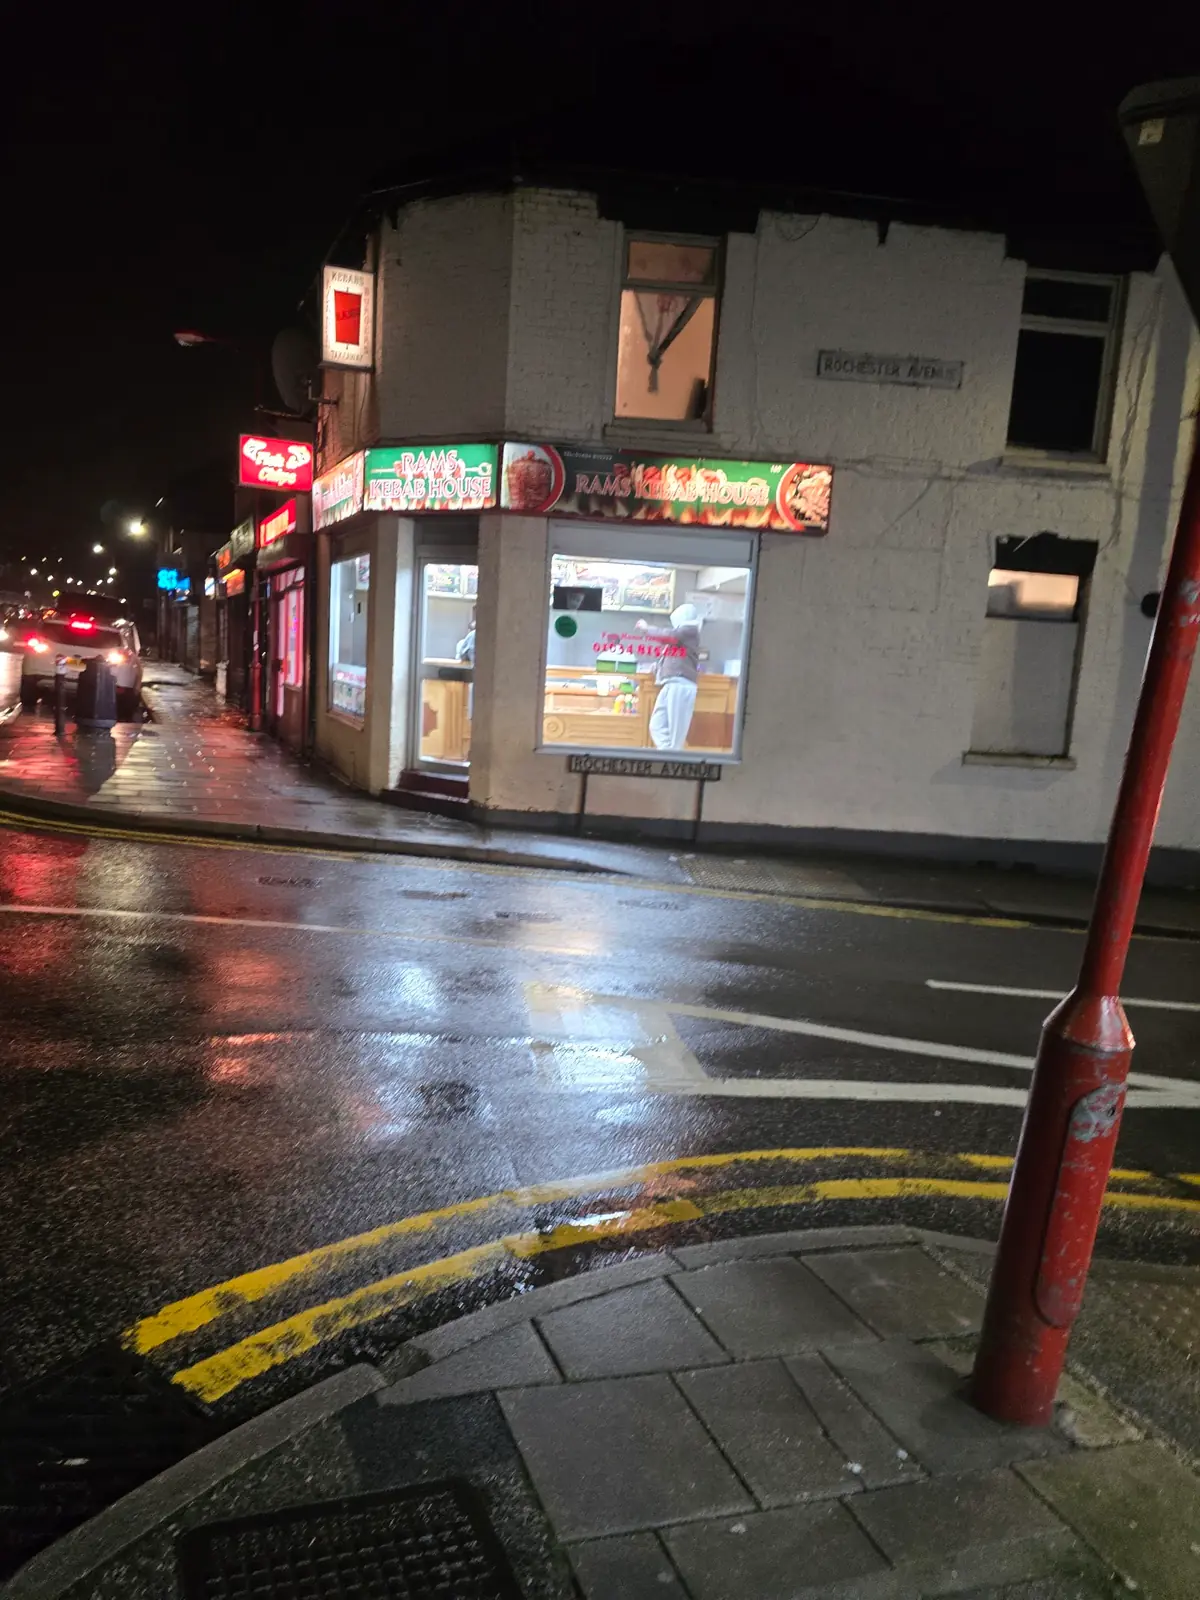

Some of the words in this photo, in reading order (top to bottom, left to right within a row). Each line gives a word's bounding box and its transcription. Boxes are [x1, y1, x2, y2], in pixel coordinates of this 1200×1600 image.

[824, 358, 900, 377] ROCHESTER
[401, 449, 458, 474] RAMS
[258, 467, 297, 487] Chips
[368, 478, 427, 499] KEBAB
[429, 476, 491, 498] HOUSE
[575, 473, 631, 498] RAMS
[635, 480, 697, 503] KEBAB
[701, 482, 770, 507] HOUSE
[573, 757, 652, 775] ROCHESTER
[660, 762, 715, 779] AVENUE
